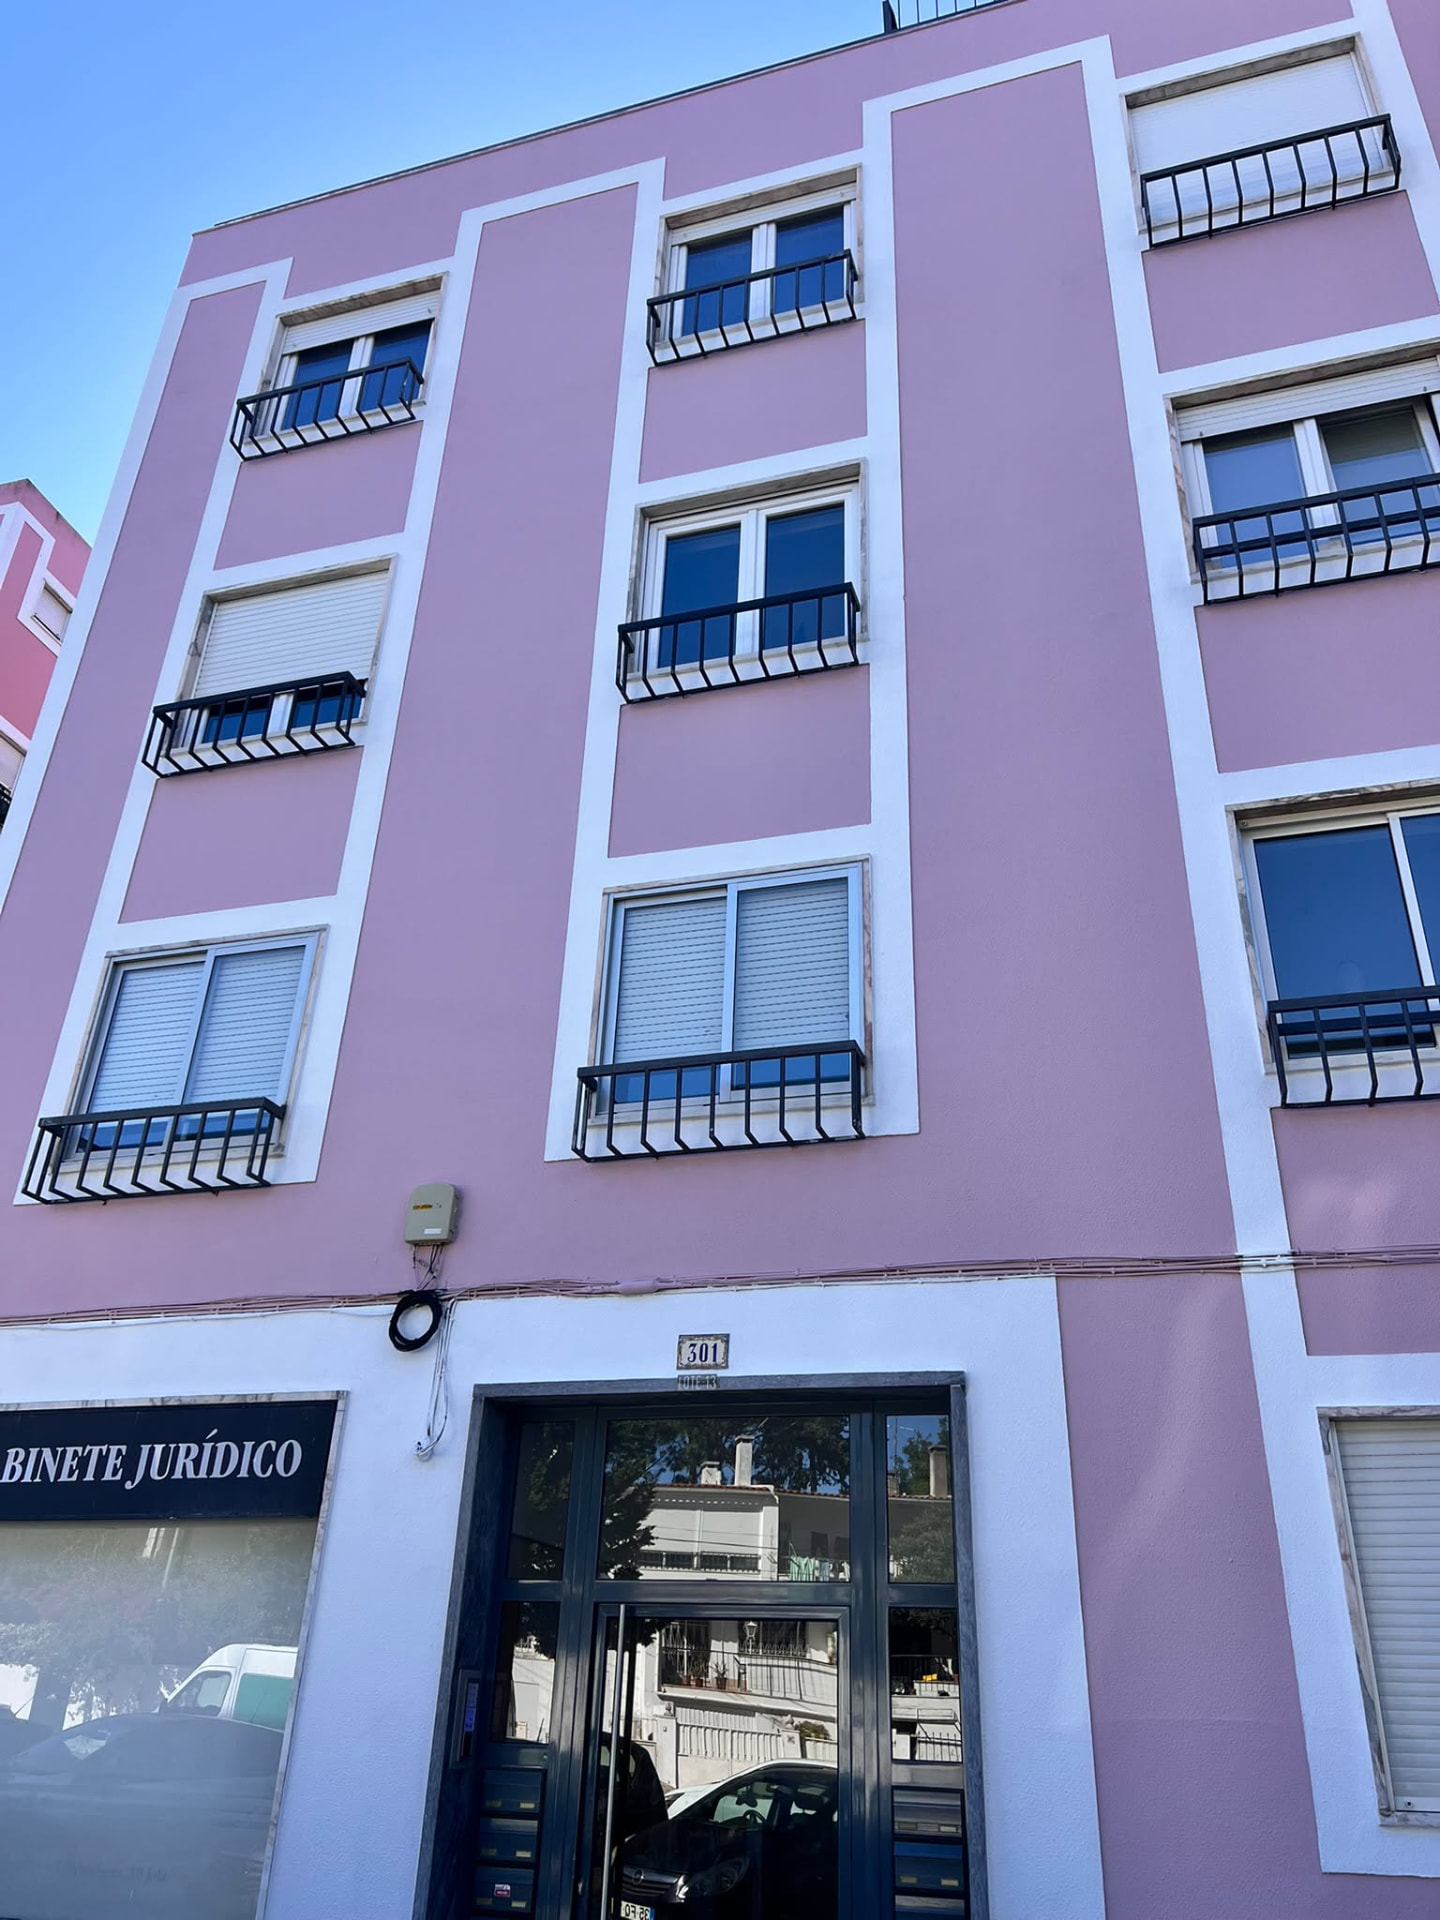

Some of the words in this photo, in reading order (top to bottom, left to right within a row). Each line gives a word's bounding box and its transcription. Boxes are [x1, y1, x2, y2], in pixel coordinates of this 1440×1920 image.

[687, 1343, 718, 1363] 301
[0, 1445, 127, 1483] BINETE
[124, 1428, 302, 1490] JURÍDICO
